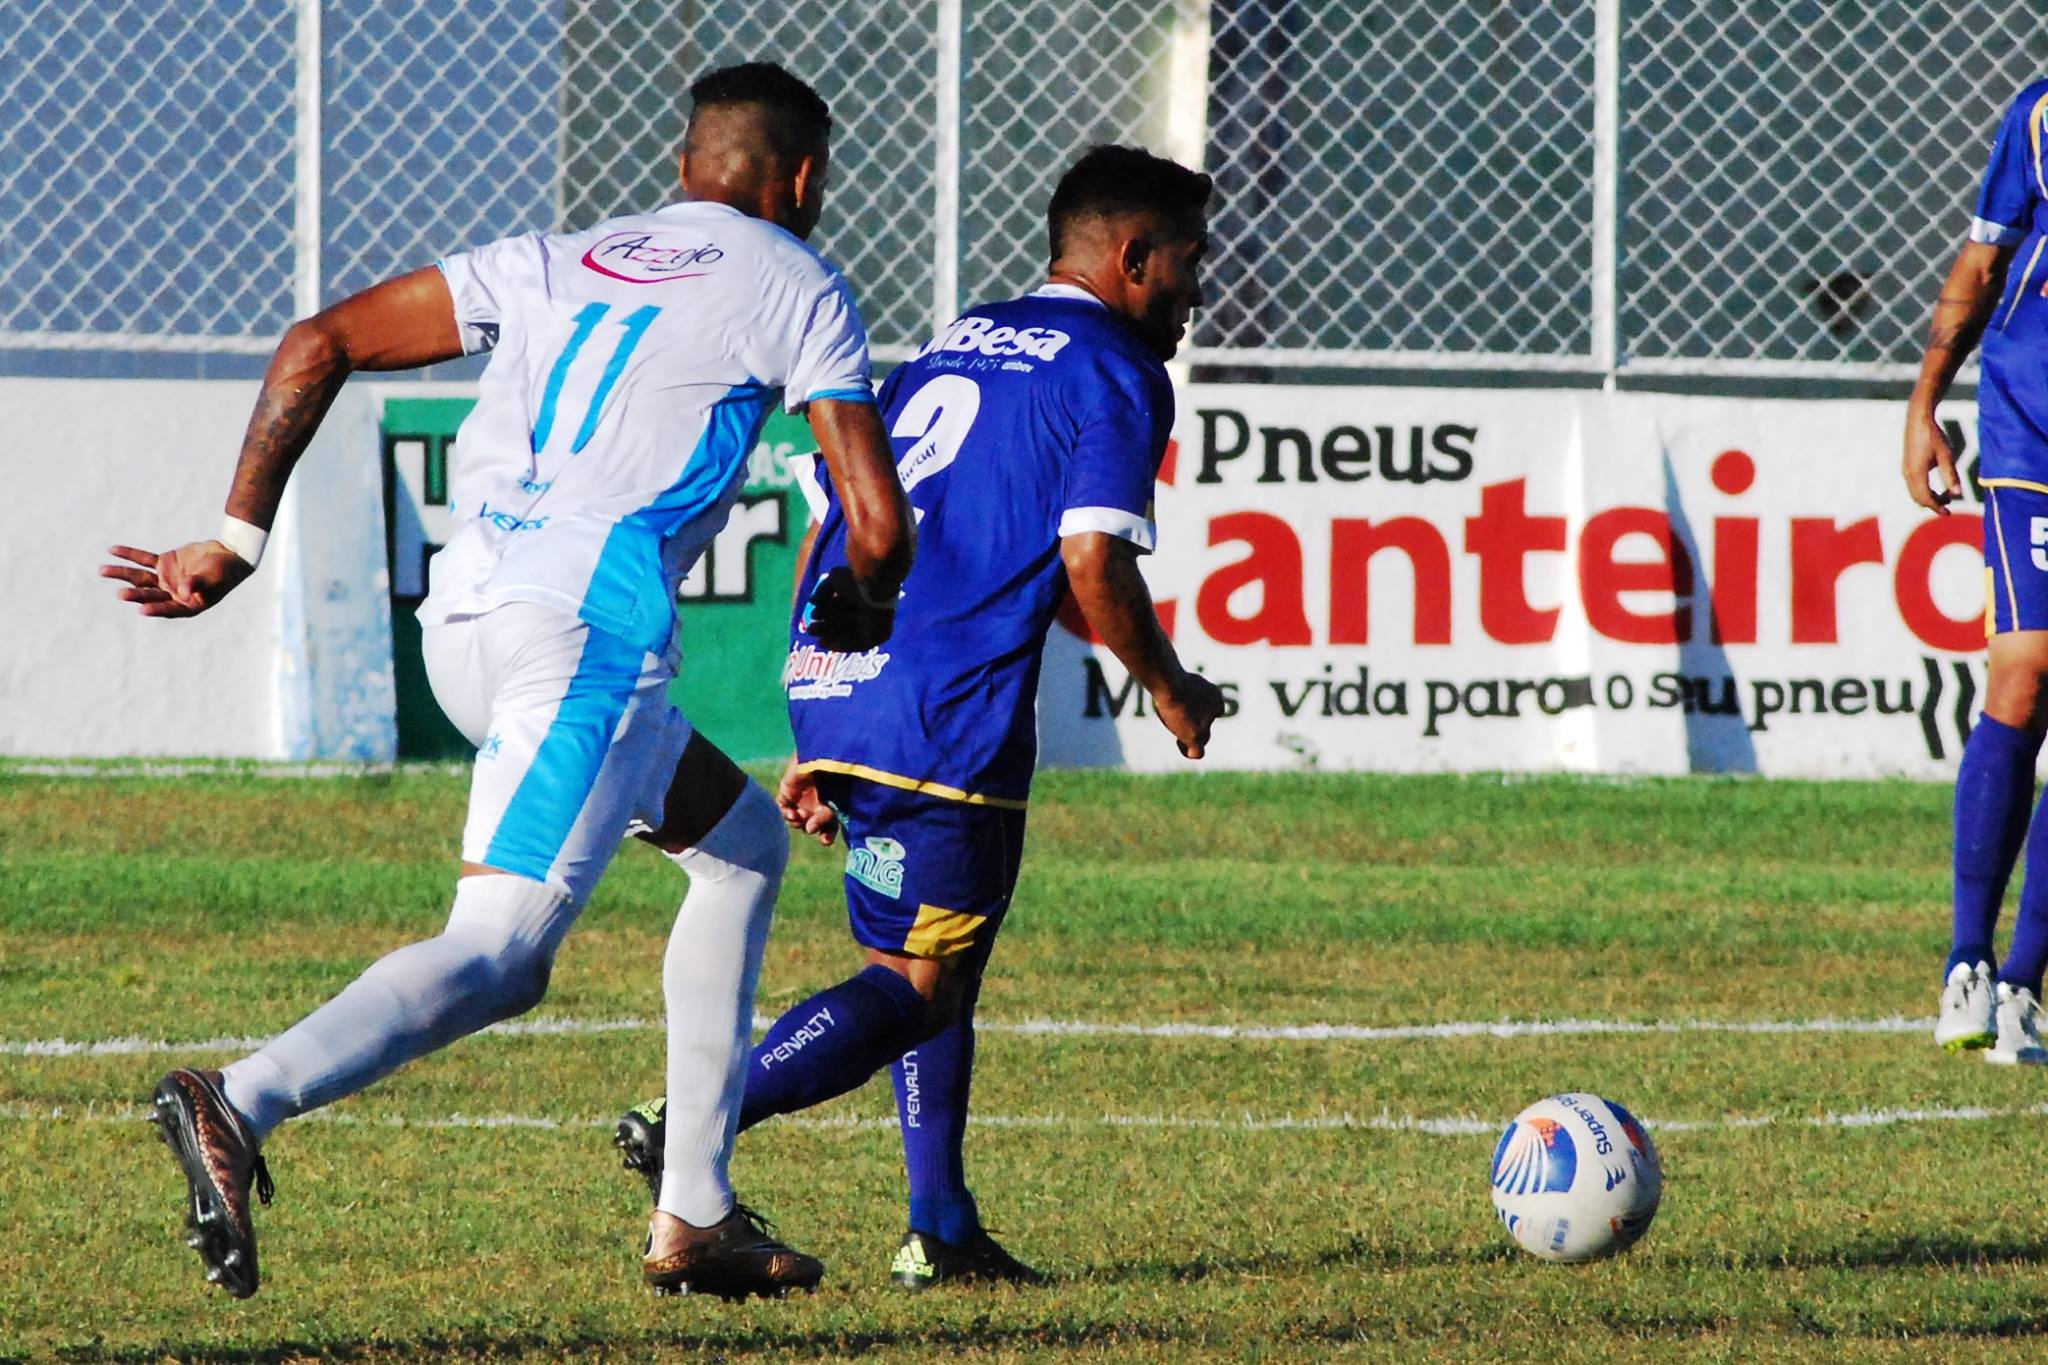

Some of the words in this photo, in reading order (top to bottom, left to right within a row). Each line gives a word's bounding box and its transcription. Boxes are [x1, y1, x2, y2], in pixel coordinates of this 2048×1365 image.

[532, 302, 663, 454] 11
[892, 373, 982, 525] 2
[1195, 409, 1478, 484] Pneus
[1269, 665, 1408, 717] vida
[1422, 675, 1595, 737] para
[1606, 675, 1634, 709] o
[1746, 678, 1917, 731] pneu
[760, 1007, 835, 1070] PENALTY
[1573, 1106, 1613, 1155] Super
